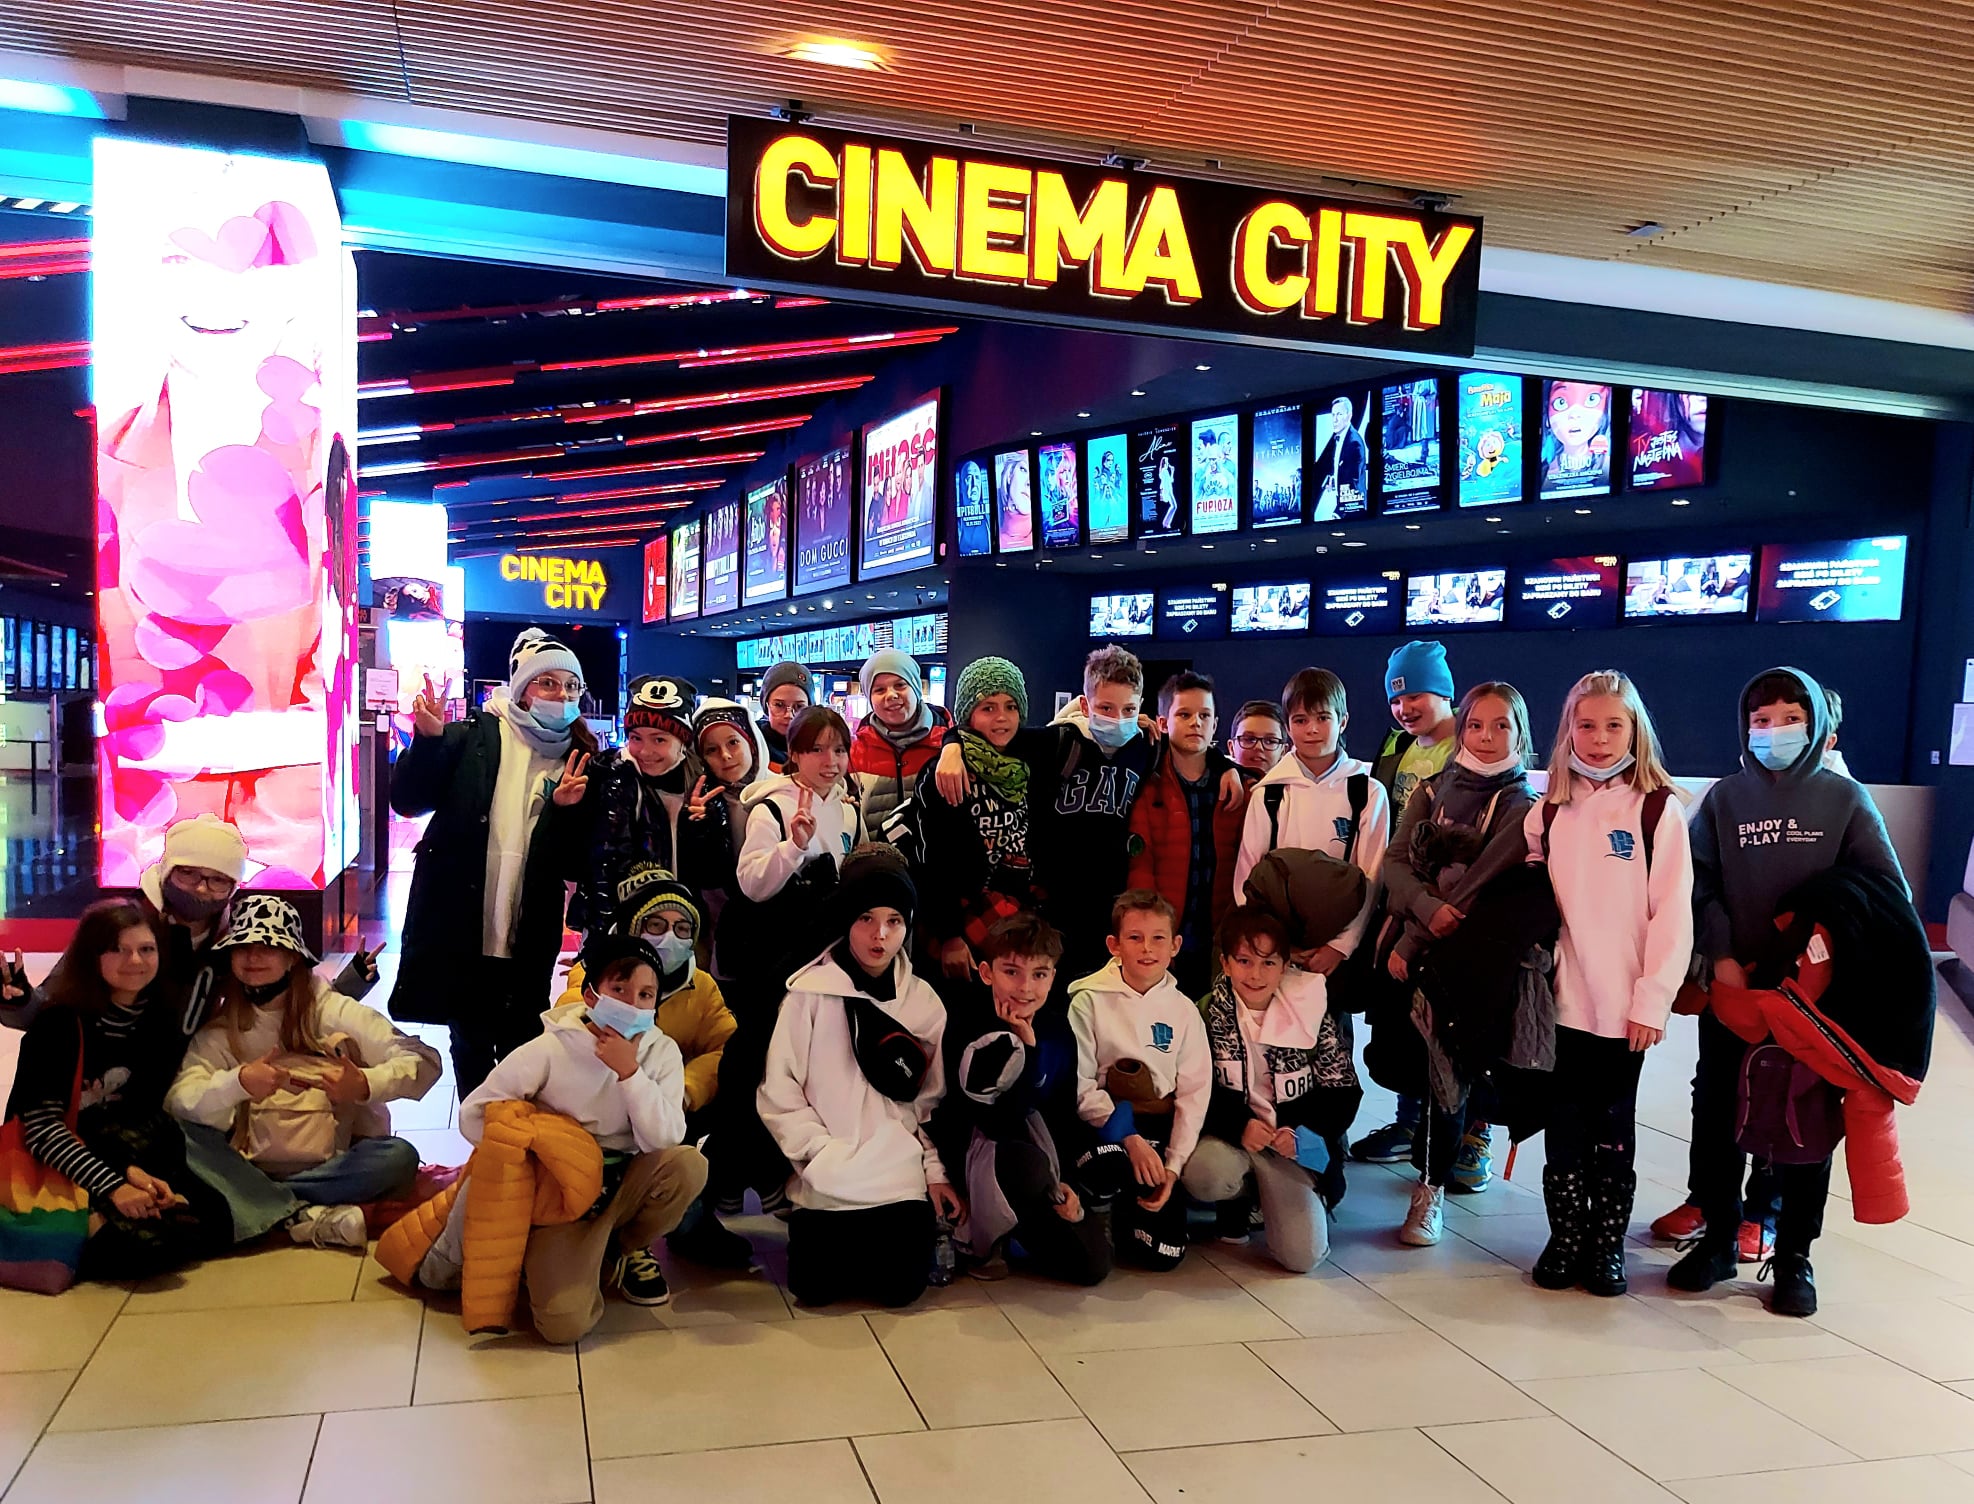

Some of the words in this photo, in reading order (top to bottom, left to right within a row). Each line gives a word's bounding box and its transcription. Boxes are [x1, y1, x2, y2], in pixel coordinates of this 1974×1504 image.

[754, 134, 1203, 306] CINEMA
[1231, 202, 1476, 331] CITY
[1633, 432, 1651, 457] TY
[960, 504, 986, 517] PITBULL
[1197, 499, 1233, 515] FURIOZA
[800, 546, 818, 567] DOM
[821, 537, 849, 563] GUCCI
[501, 554, 607, 586] CINEMA
[546, 583, 607, 610] CITY
[1738, 819, 1783, 836] ENJOY
[1787, 818, 1798, 829] &
[1739, 832, 1781, 848] P-LAY
